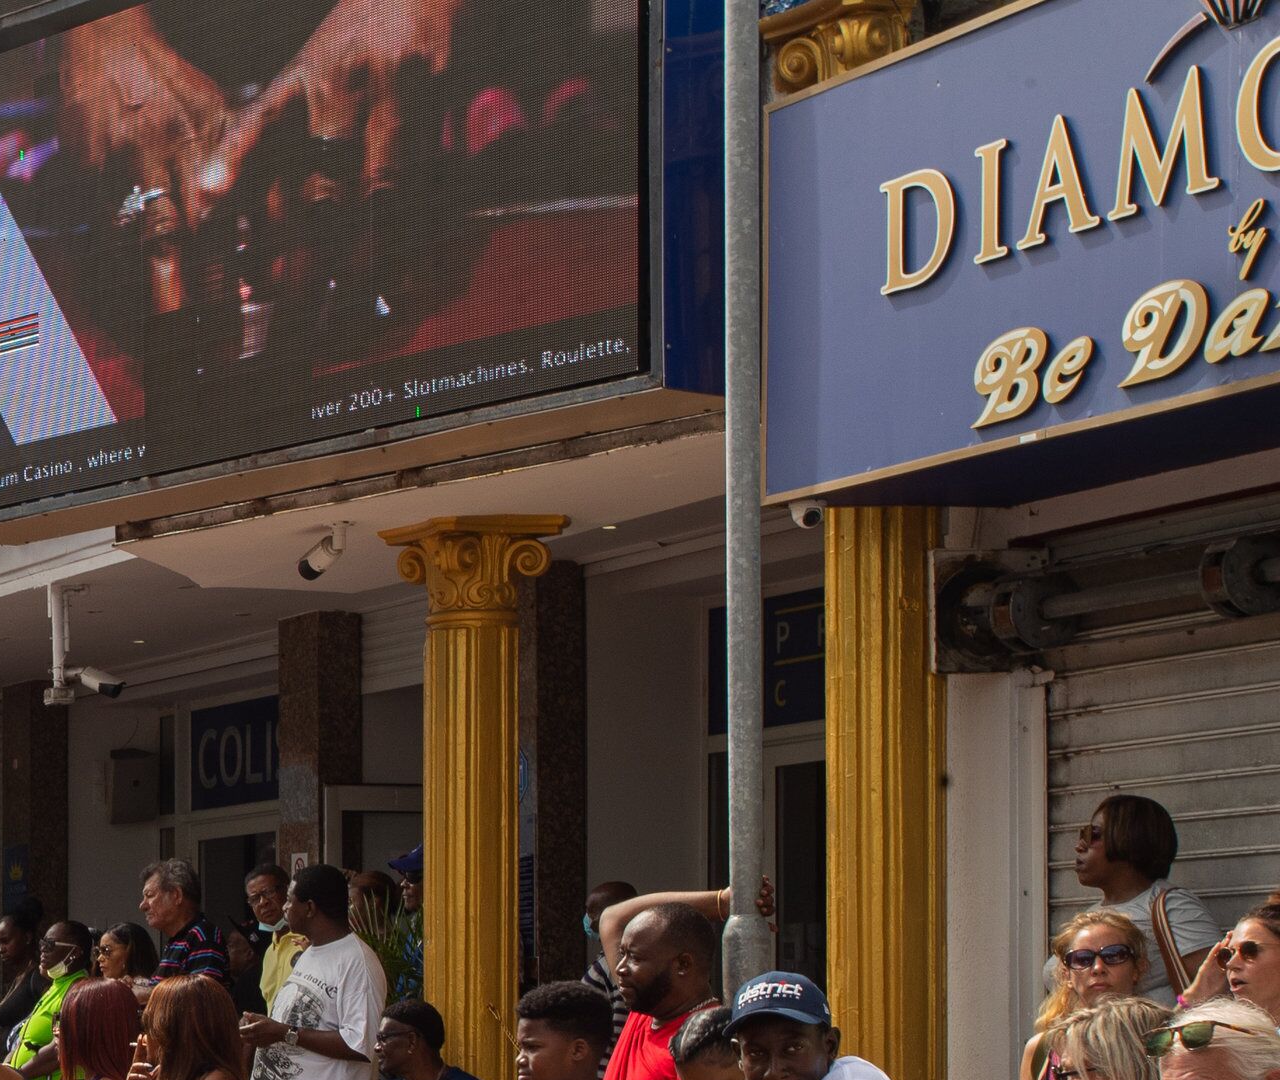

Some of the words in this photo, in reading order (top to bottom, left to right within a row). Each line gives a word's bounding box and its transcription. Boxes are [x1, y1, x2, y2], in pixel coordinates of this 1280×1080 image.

[1228, 198, 1270, 280] by
[970, 326, 1095, 429] Be
[348, 388, 396, 411] 200+
[23, 459, 73, 482] Casino
[87, 446, 133, 468] where
[737, 981, 803, 1003] district
